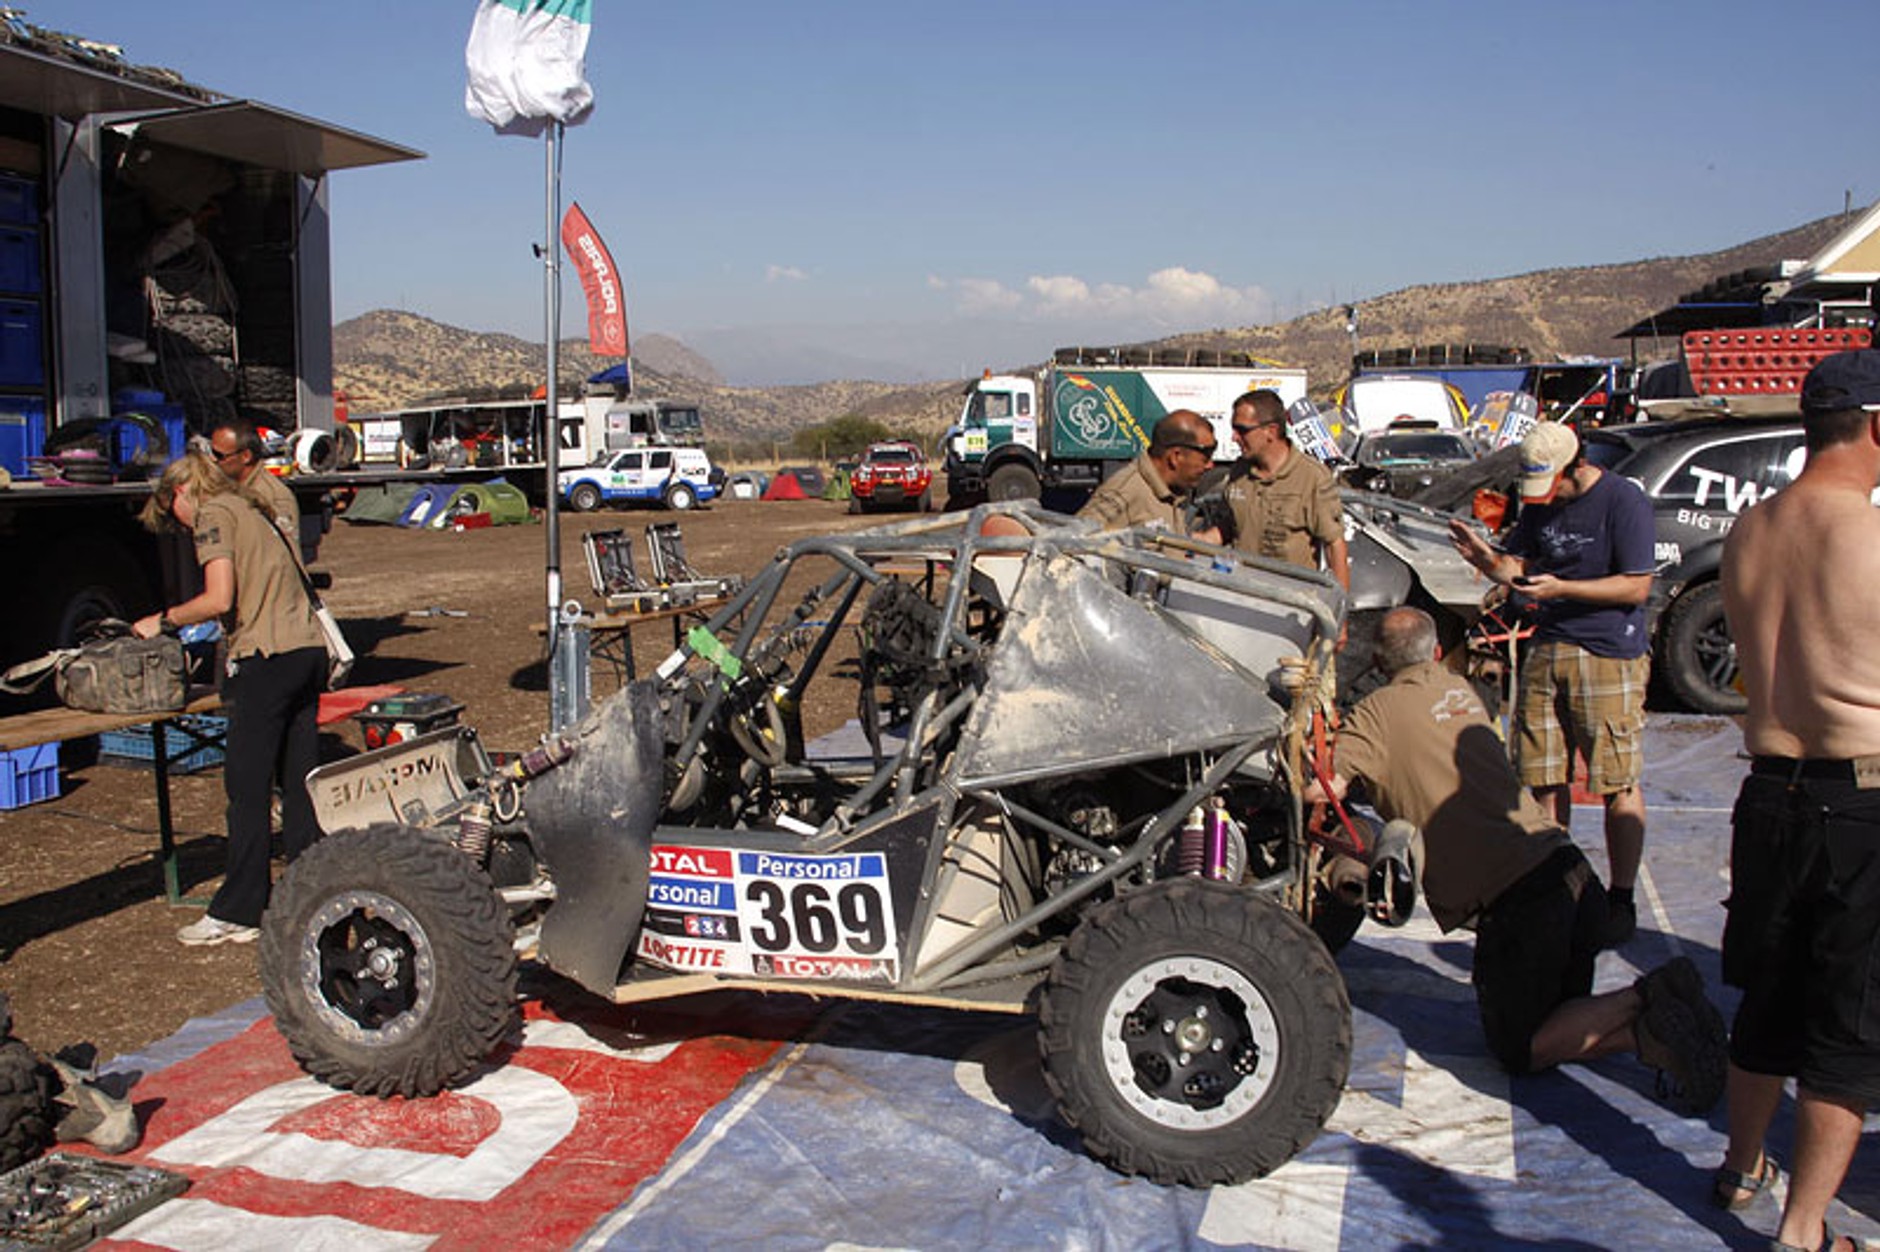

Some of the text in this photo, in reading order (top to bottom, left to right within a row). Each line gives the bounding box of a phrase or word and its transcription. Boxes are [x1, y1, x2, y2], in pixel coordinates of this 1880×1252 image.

[1677, 509, 1712, 531] BIG
[757, 854, 861, 879] Personal
[747, 880, 887, 955] 369
[643, 934, 726, 967] LOCTITE
[774, 956, 869, 979] TOTAL
